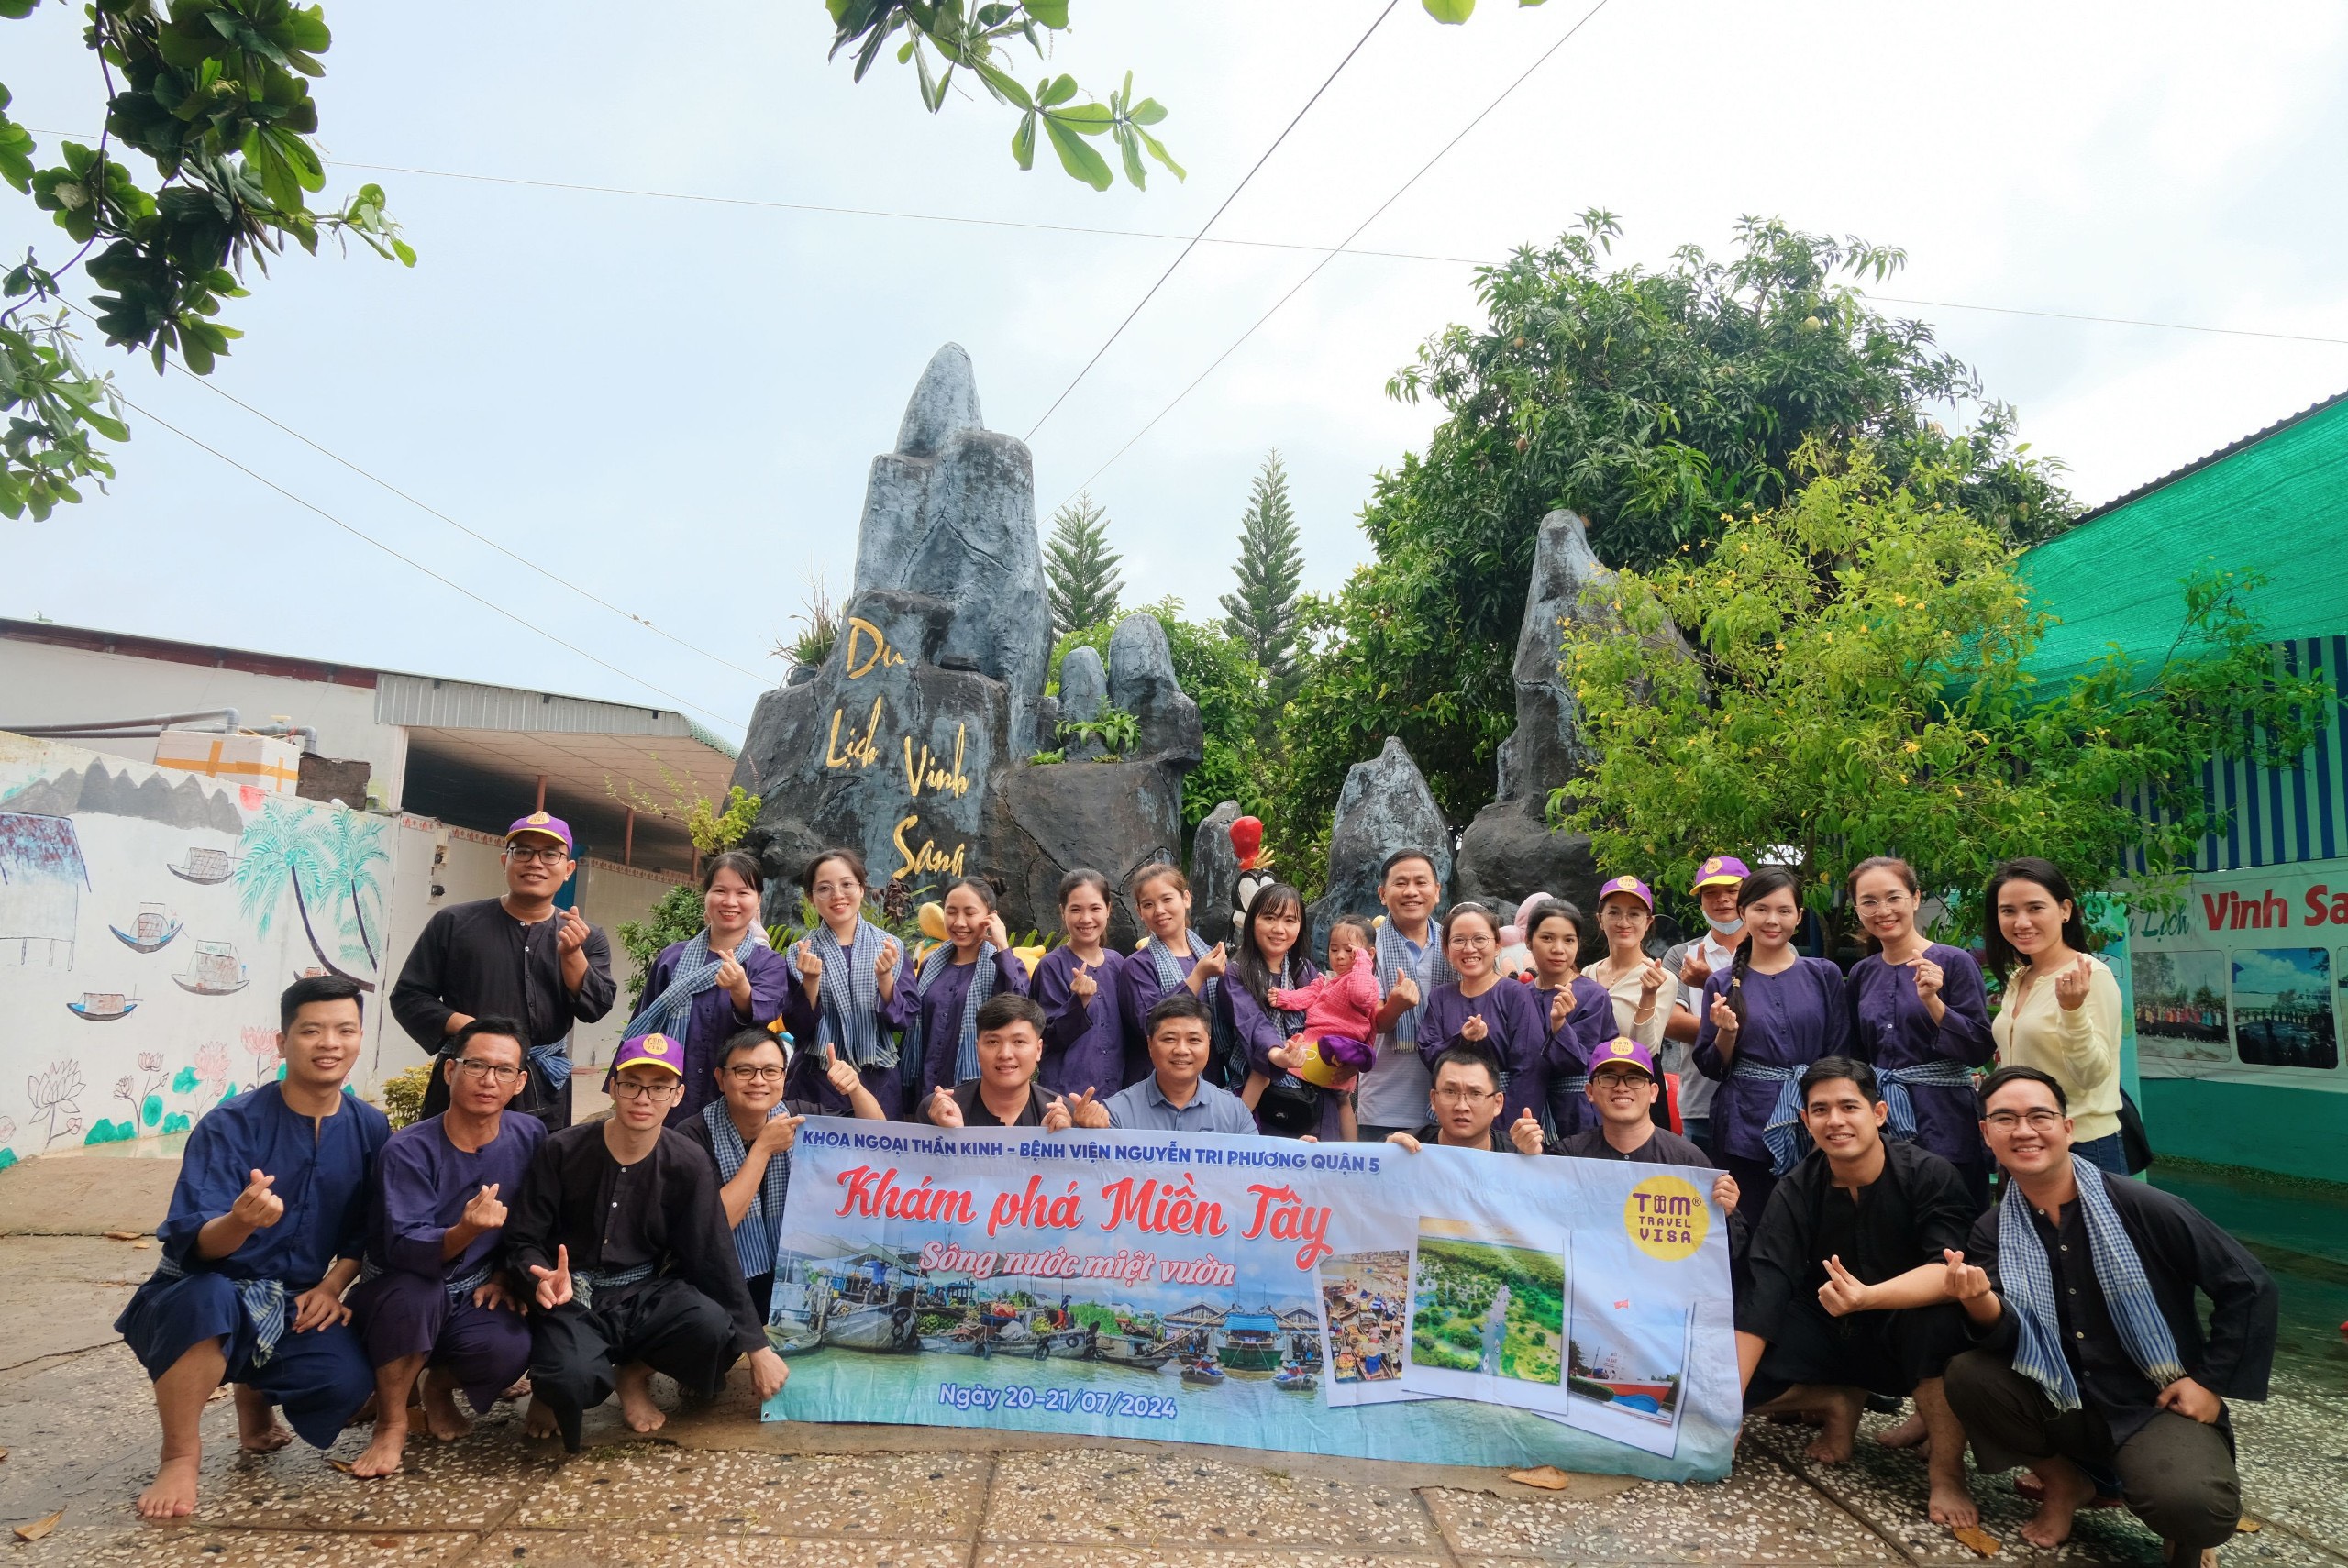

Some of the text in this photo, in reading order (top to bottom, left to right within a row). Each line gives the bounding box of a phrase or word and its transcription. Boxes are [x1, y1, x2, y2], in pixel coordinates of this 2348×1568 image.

[846, 616, 906, 680] Du
[826, 695, 881, 769] Lịch
[903, 722, 969, 799] Vinh
[891, 813, 966, 879] Sang
[2201, 889, 2288, 931] Vinh
[803, 1130, 851, 1147] KHOA
[854, 1132, 909, 1156] NGOẠI
[911, 1135, 957, 1156] THẦN
[960, 1142, 1003, 1156] KINH
[1019, 1140, 1066, 1162] BỆNH
[1070, 1141, 1111, 1164] VIỆN
[1115, 1141, 1191, 1163] NGUYỄN
[1194, 1148, 1223, 1165] TRI
[1227, 1149, 1307, 1169] PHƯƠNG
[1311, 1153, 1365, 1175] QUẬN
[1368, 1157, 1380, 1173] 5
[834, 1165, 1334, 1271] Khám phá Miền Tây
[1638, 1215, 1692, 1229] TRAVEL
[1639, 1228, 1691, 1244] VISA
[918, 1241, 1236, 1287] Sông nước miệt vườn
[938, 1383, 1178, 1420] Ngày 20-21/07/2024
